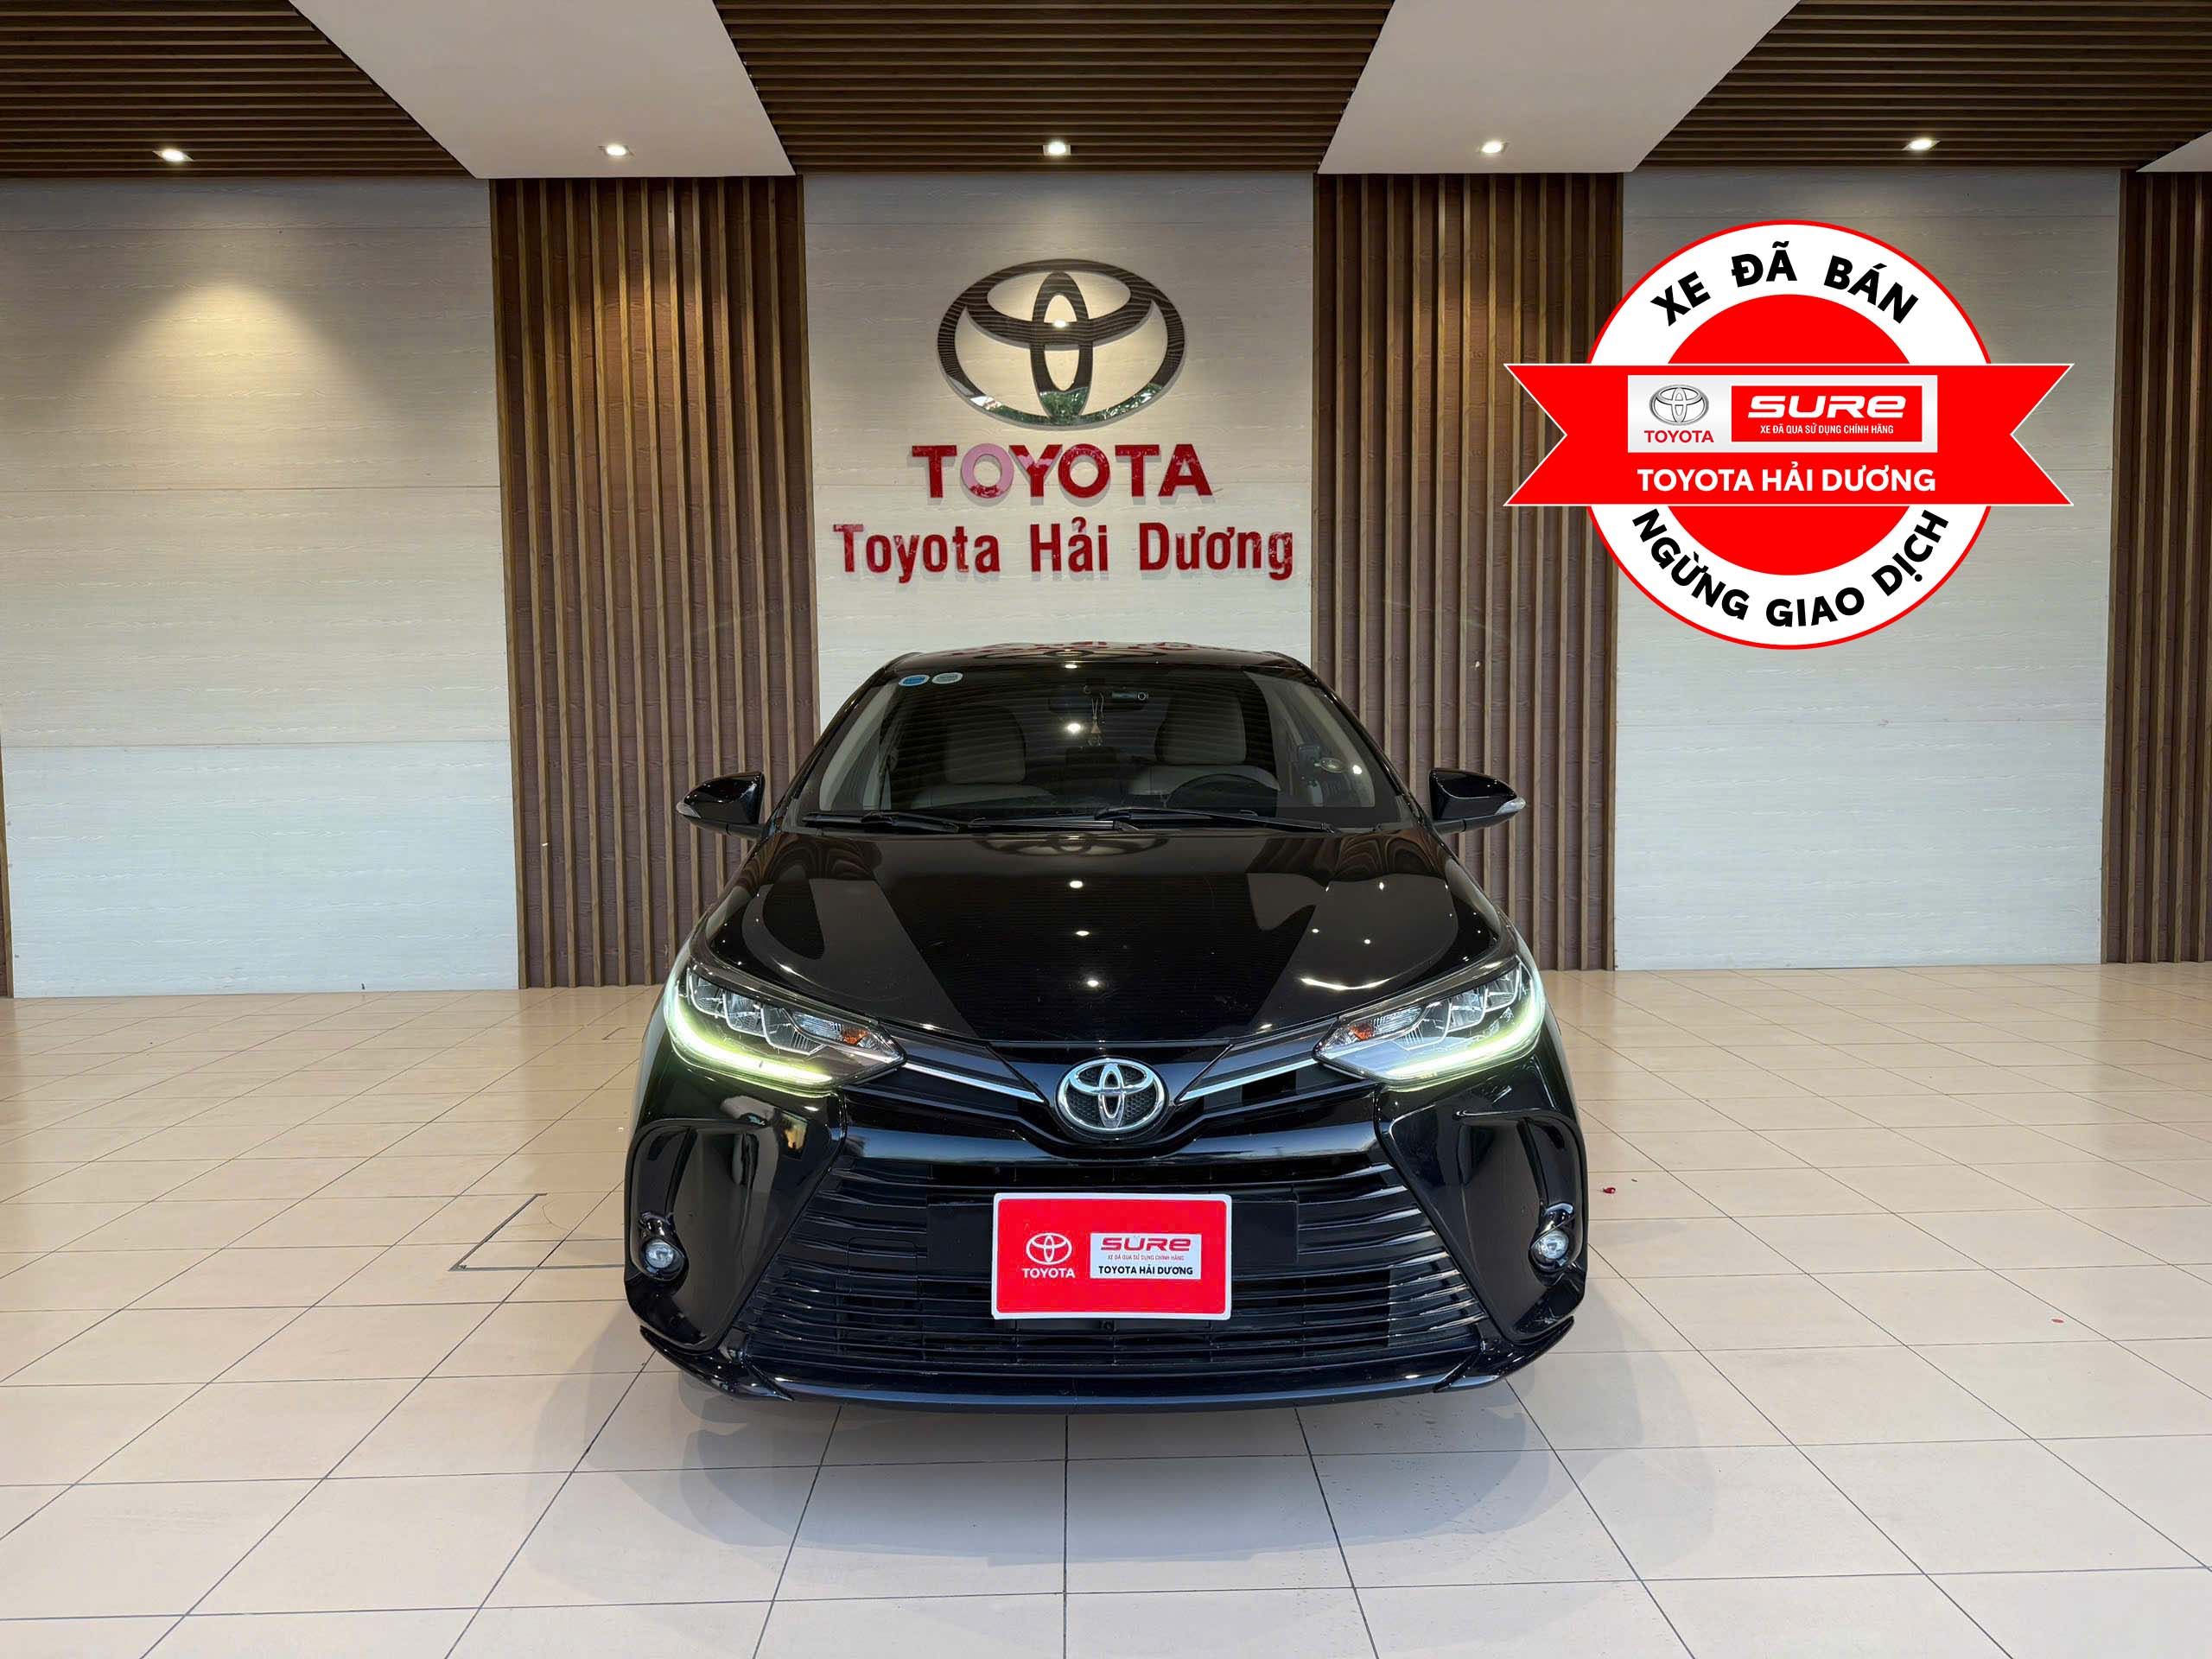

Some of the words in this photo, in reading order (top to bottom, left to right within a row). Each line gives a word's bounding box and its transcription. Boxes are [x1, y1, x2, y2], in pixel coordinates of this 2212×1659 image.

[911, 442, 1214, 499] TOYOTA
[833, 524, 1001, 584] Toyota
[1029, 516, 1109, 573] Hải
[1139, 521, 1294, 581] Dương
[1023, 1268, 1075, 1278] TOYOTA
[1099, 1266, 1137, 1274] TOYOTA
[1140, 1263, 1155, 1275] HẢI
[1157, 1267, 1193, 1275] DƯƠNG
